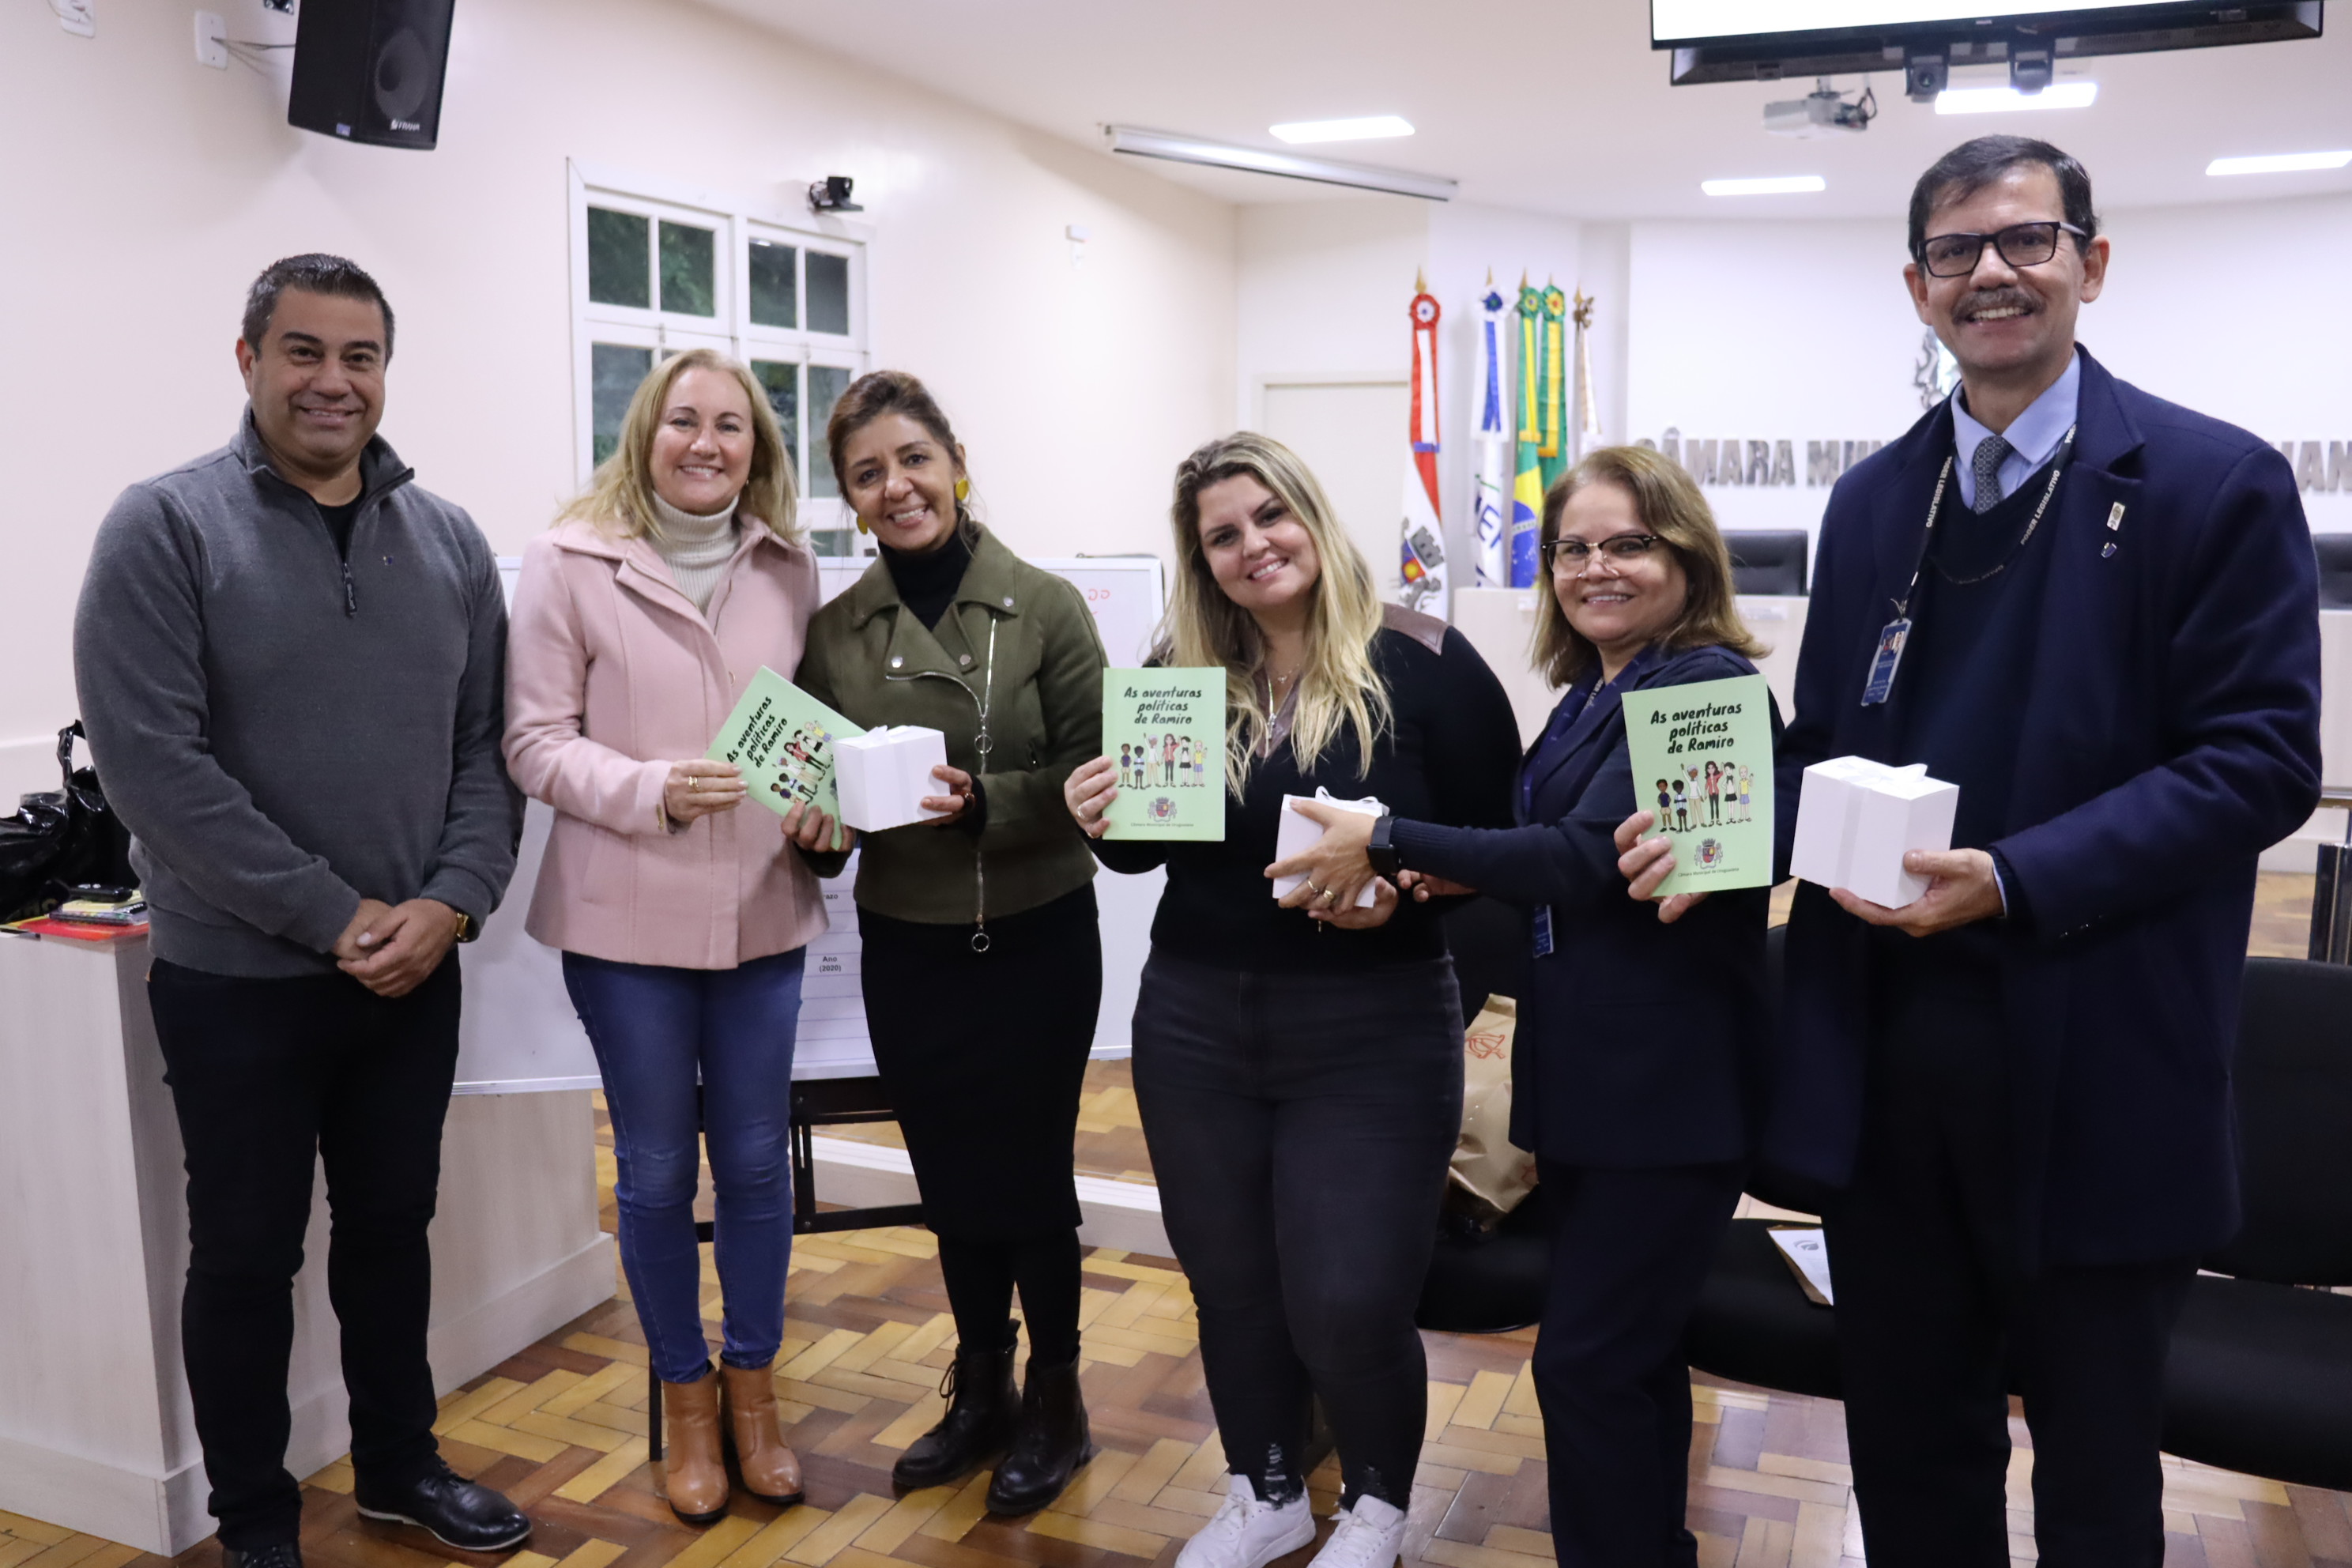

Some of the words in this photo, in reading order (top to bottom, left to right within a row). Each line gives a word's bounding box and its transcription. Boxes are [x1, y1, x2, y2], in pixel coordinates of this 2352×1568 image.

[1635, 427, 1796, 486] ÂMARA
[1807, 440, 1898, 487] MU
[1939, 455, 1953, 479] PODER
[1926, 478, 1946, 528] LEGISLATIVO
[2020, 518, 2038, 545] PODER
[2034, 469, 2060, 518] LEGISLATIVO
[1124, 686, 1138, 698] As
[1142, 686, 1202, 698] aventuras
[1137, 699, 1188, 714] políticas
[1650, 710, 1667, 725] As
[1672, 702, 1742, 722] aventuras
[726, 749, 739, 763] As
[737, 696, 772, 748] aventuras
[1134, 713, 1148, 724] de
[1152, 713, 1192, 725] Ramiro
[747, 714, 775, 762] políticas
[1669, 720, 1728, 742] políticas
[753, 754, 765, 768] de
[761, 718, 787, 754] Ramiro
[1668, 740, 1683, 754] de
[1688, 735, 1734, 752] Ramiro
[819, 964, 842, 973] (2020)
